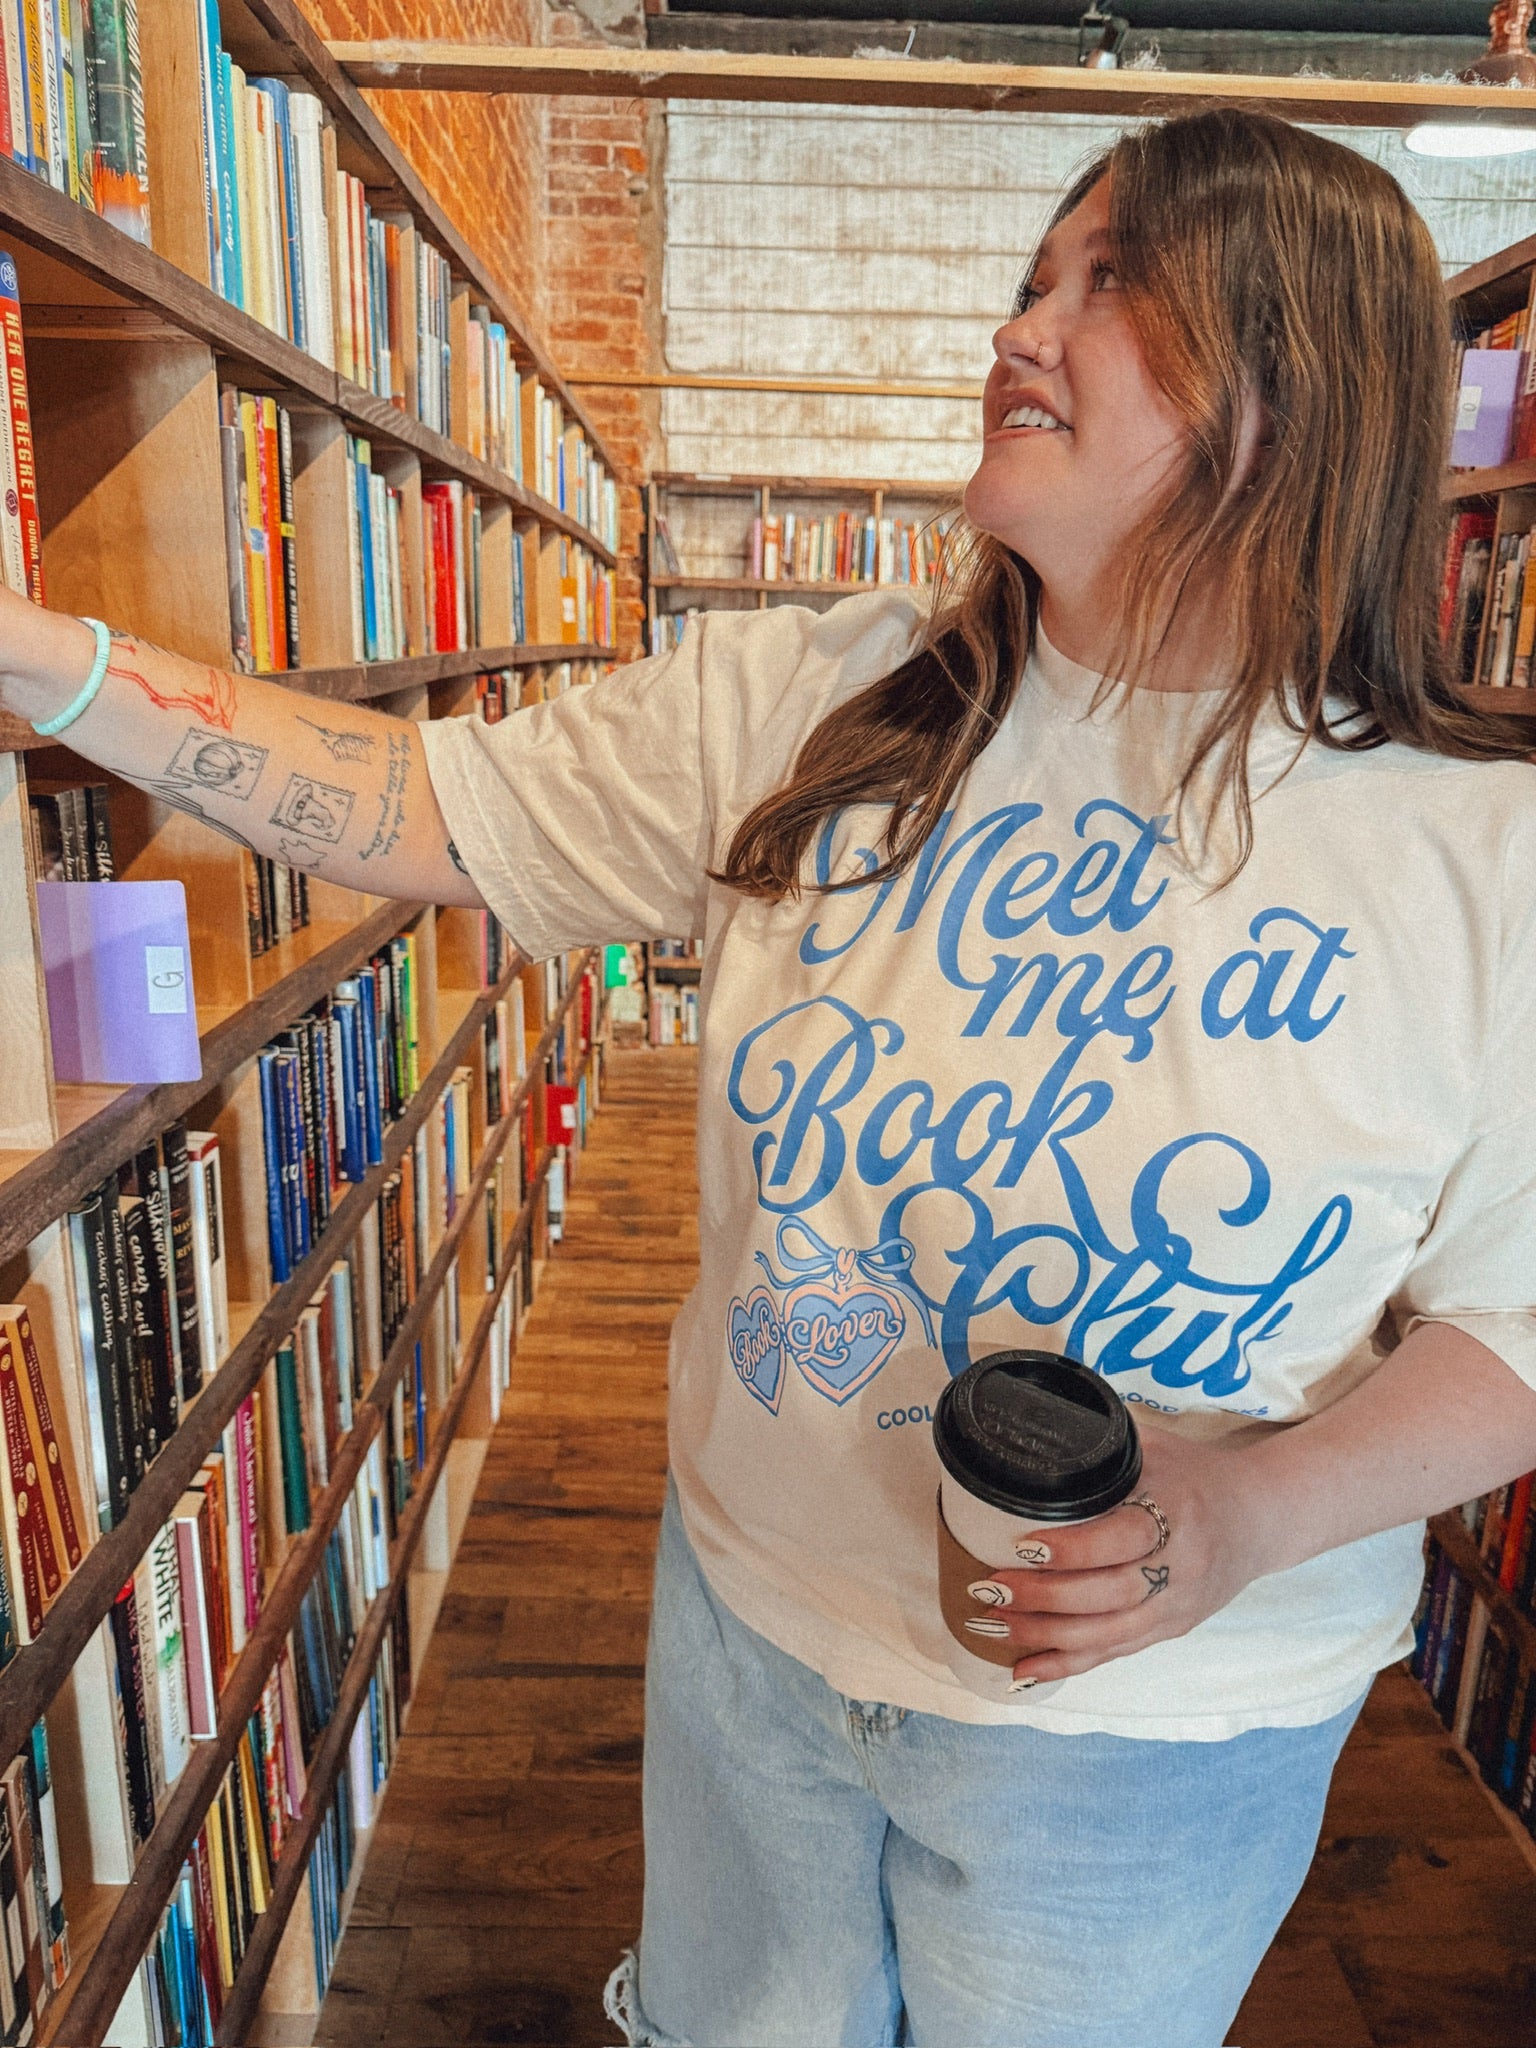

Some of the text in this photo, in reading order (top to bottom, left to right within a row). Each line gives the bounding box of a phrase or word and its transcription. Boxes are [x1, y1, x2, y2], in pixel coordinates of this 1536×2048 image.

[47, 48, 63, 174] CHRISTMAS
[5, 311, 22, 357] HER
[10, 366, 28, 412] ONE
[15, 419, 36, 505] REGRET
[27, 519, 40, 561] DONNA
[799, 798, 1177, 970] Meet
[153, 970, 184, 989] G
[958, 907, 1357, 1062] me at
[727, 994, 1116, 1214] Book
[95, 1230, 108, 1290] cuckoo's
[116, 1268, 129, 1324] calling
[879, 1132, 1353, 1398] Club
[100, 1291, 114, 1350] calling
[134, 1299, 155, 1337] evil
[733, 1306, 904, 1380] Book Lover
[5, 1397, 14, 1435] BITTER
[12, 1447, 20, 1478] SWEET
[9, 1380, 17, 1412] HOTEL
[16, 1437, 25, 1478] CORNER
[877, 1404, 935, 1431] COOL
[153, 1544, 174, 1630] WHITE
[126, 1595, 138, 1639] LIKE
[133, 1658, 145, 1722] SISTER
